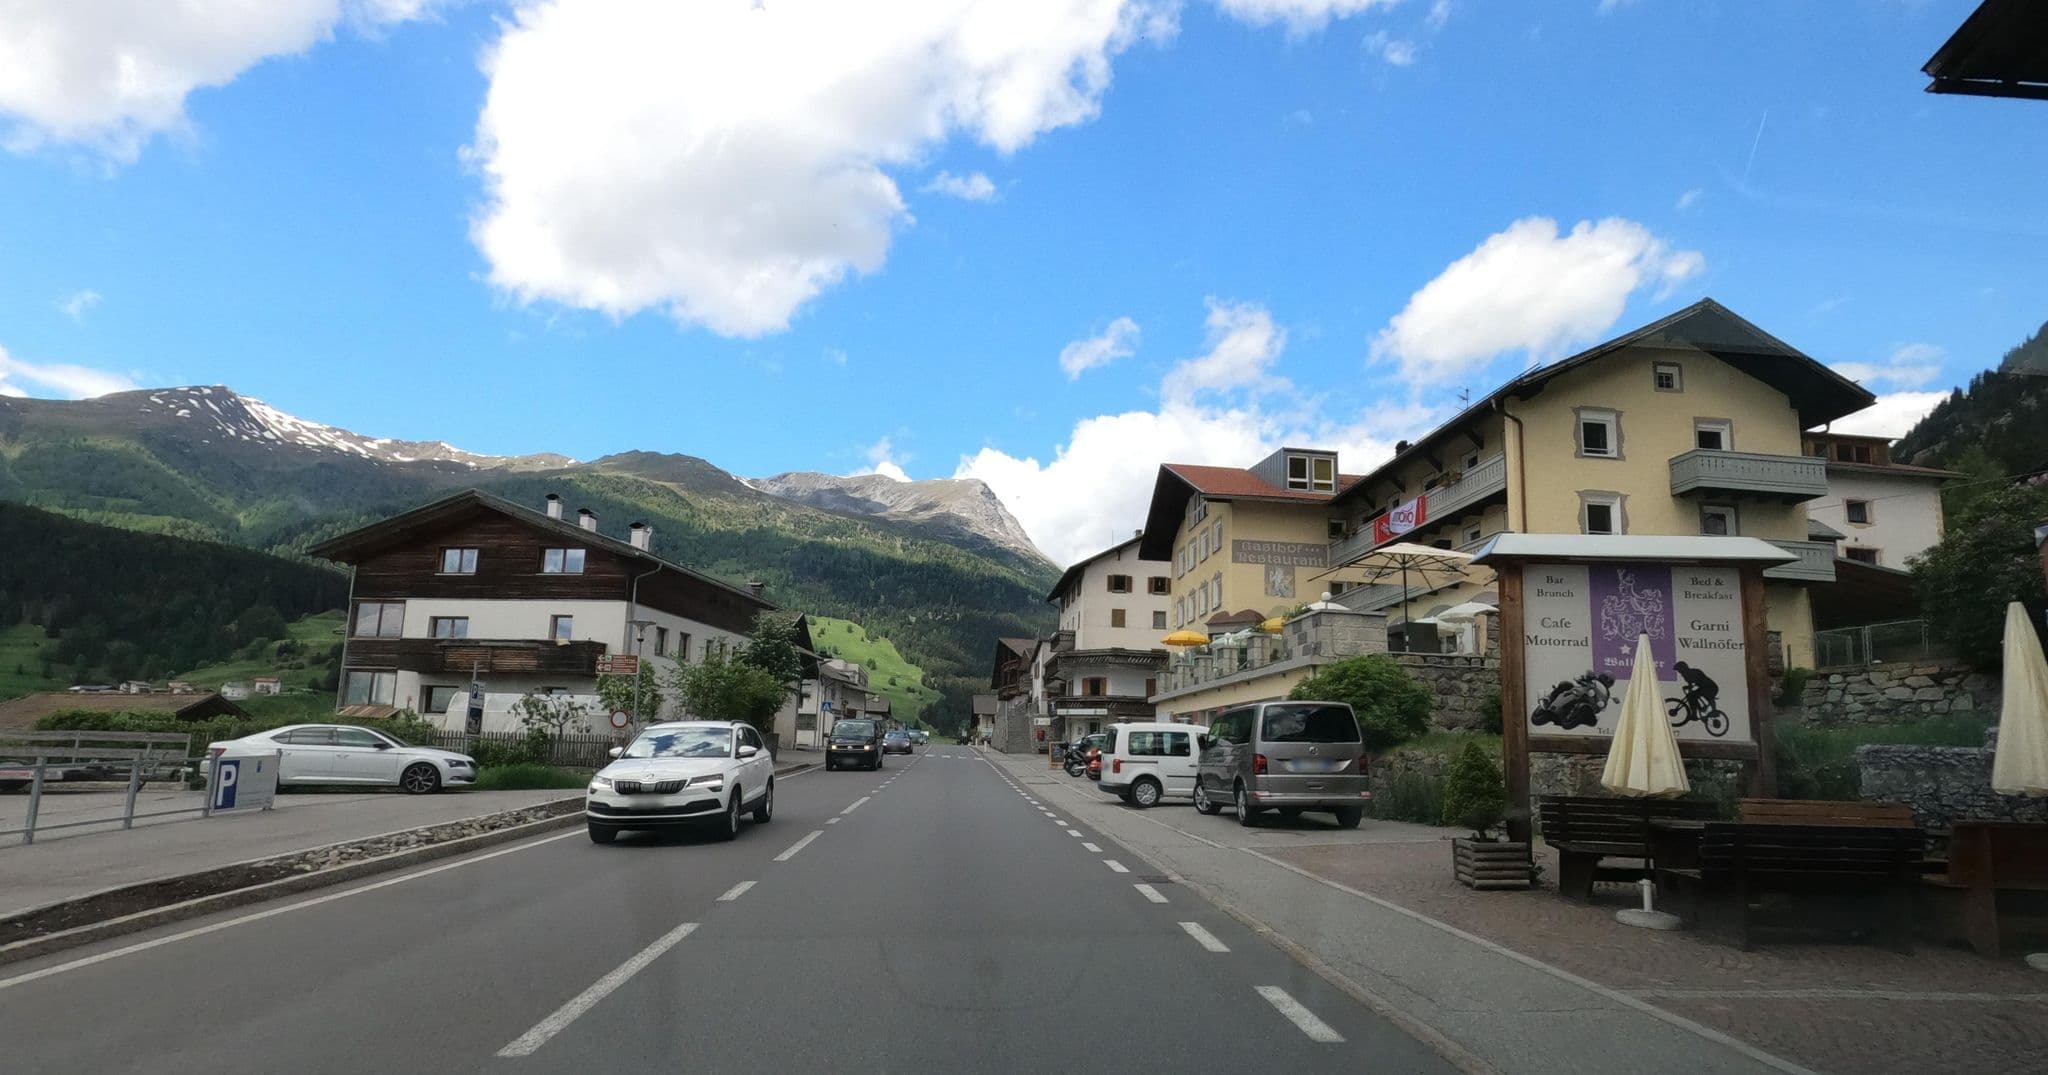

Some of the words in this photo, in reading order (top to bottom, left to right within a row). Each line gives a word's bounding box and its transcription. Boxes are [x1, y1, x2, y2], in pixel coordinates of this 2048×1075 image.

[1241, 541, 1303, 554] Gasthof
[1238, 551, 1324, 567] Restaurant
[1546, 575, 1564, 584] Bar
[1691, 577, 1711, 586] Bed
[1714, 577, 1725, 586] &
[1537, 588, 1574, 598] Brunch
[1684, 590, 1733, 600] Breakfast
[1541, 617, 1572, 629] Cafe
[1690, 620, 1730, 632] Garni
[1526, 634, 1589, 647] Motorrad
[1678, 637, 1744, 650] Wallnöfer
[216, 764, 237, 807] P
